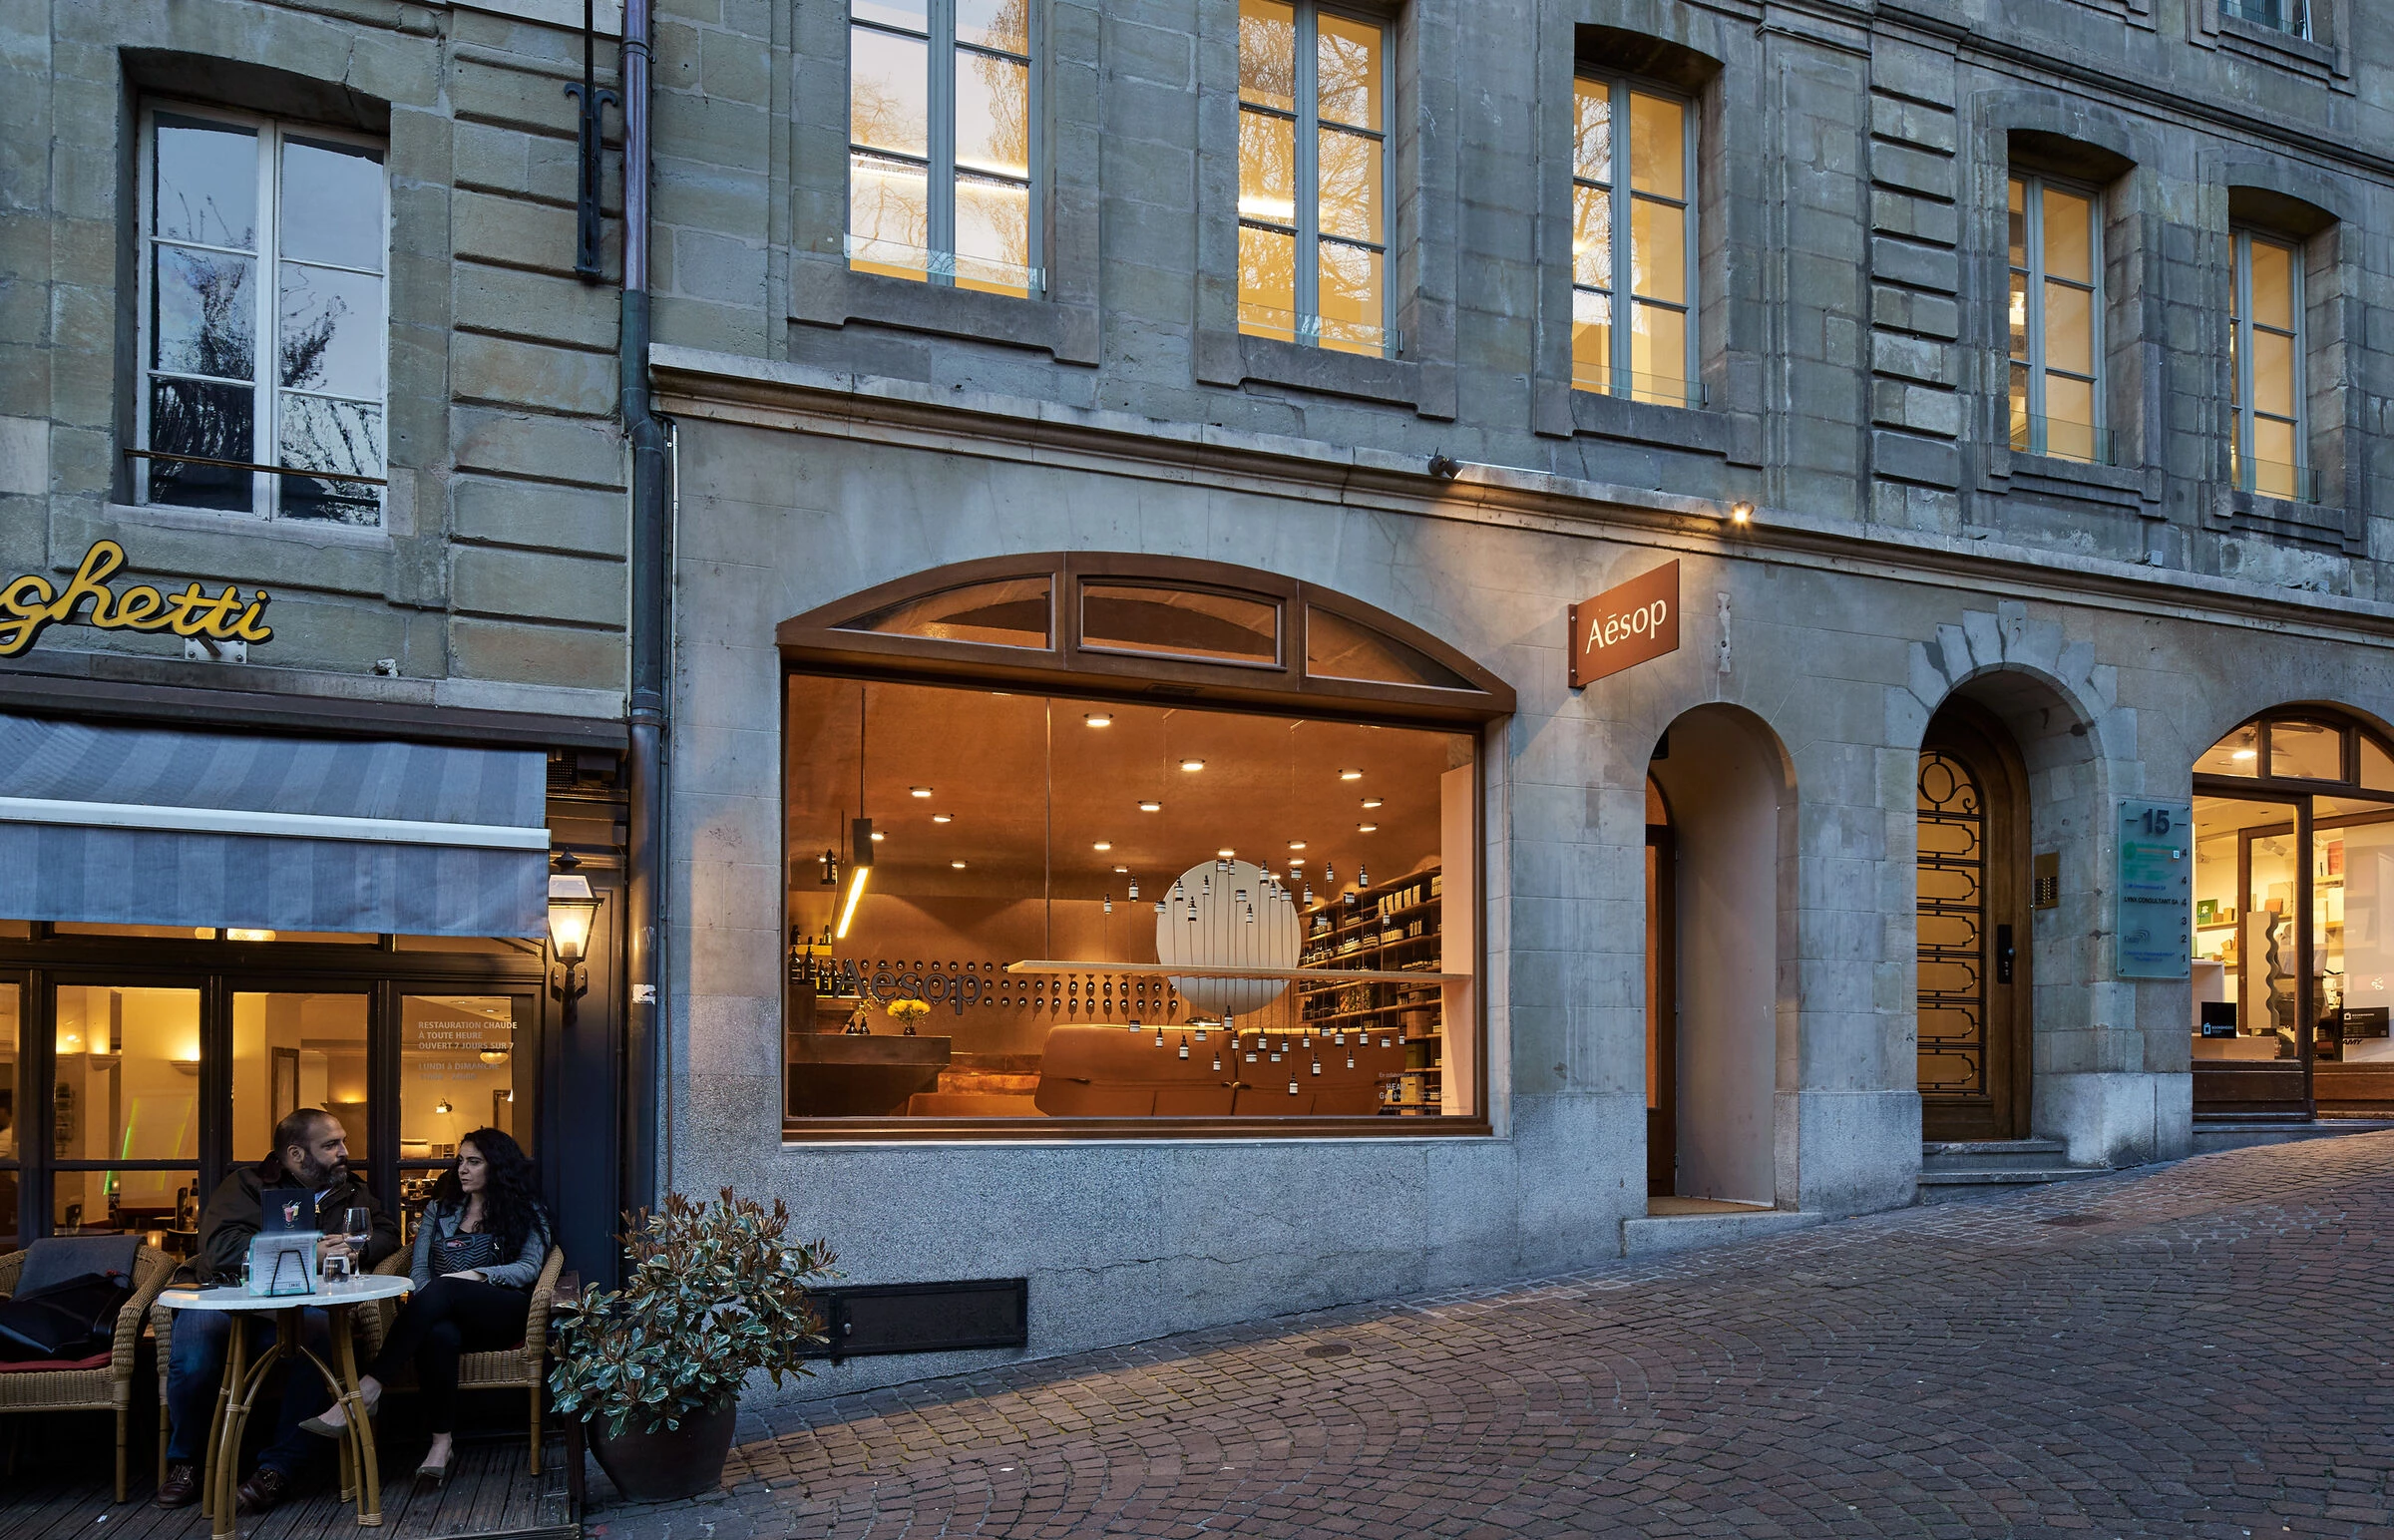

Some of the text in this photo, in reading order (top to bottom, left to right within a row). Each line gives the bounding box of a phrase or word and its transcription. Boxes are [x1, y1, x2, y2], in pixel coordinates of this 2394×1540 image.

[0, 540, 273, 658] ghetti
[2143, 808, 2171, 835] 15
[2181, 917, 2188, 926] 3
[2181, 934, 2188, 944] 2
